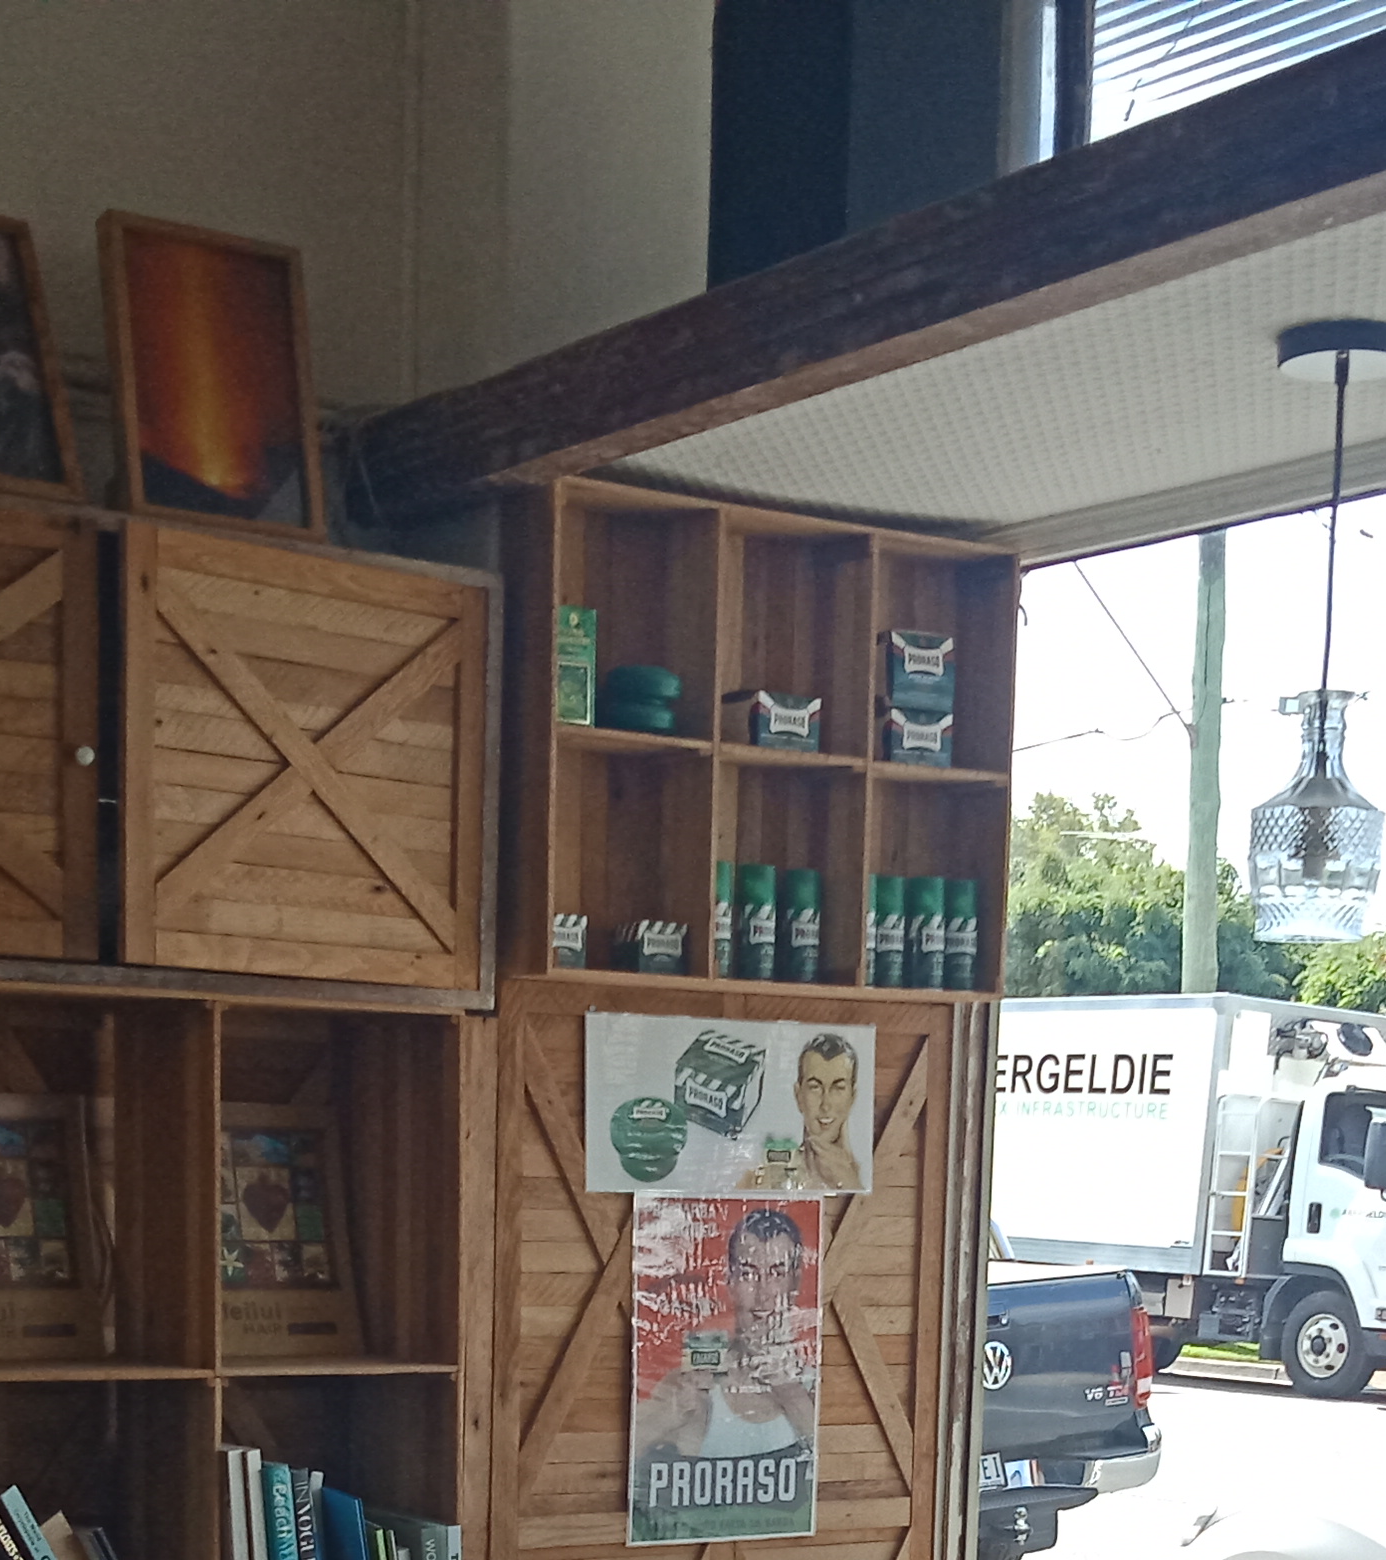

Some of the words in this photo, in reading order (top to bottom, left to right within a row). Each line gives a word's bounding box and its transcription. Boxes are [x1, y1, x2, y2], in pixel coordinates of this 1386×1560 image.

[996, 1054, 1173, 1095] ERGELDIE
[688, 1085, 724, 1110] PRORASO
[1016, 1101, 1169, 1120] INFRASTRUCTURE
[649, 1458, 797, 1508] PRORASO
